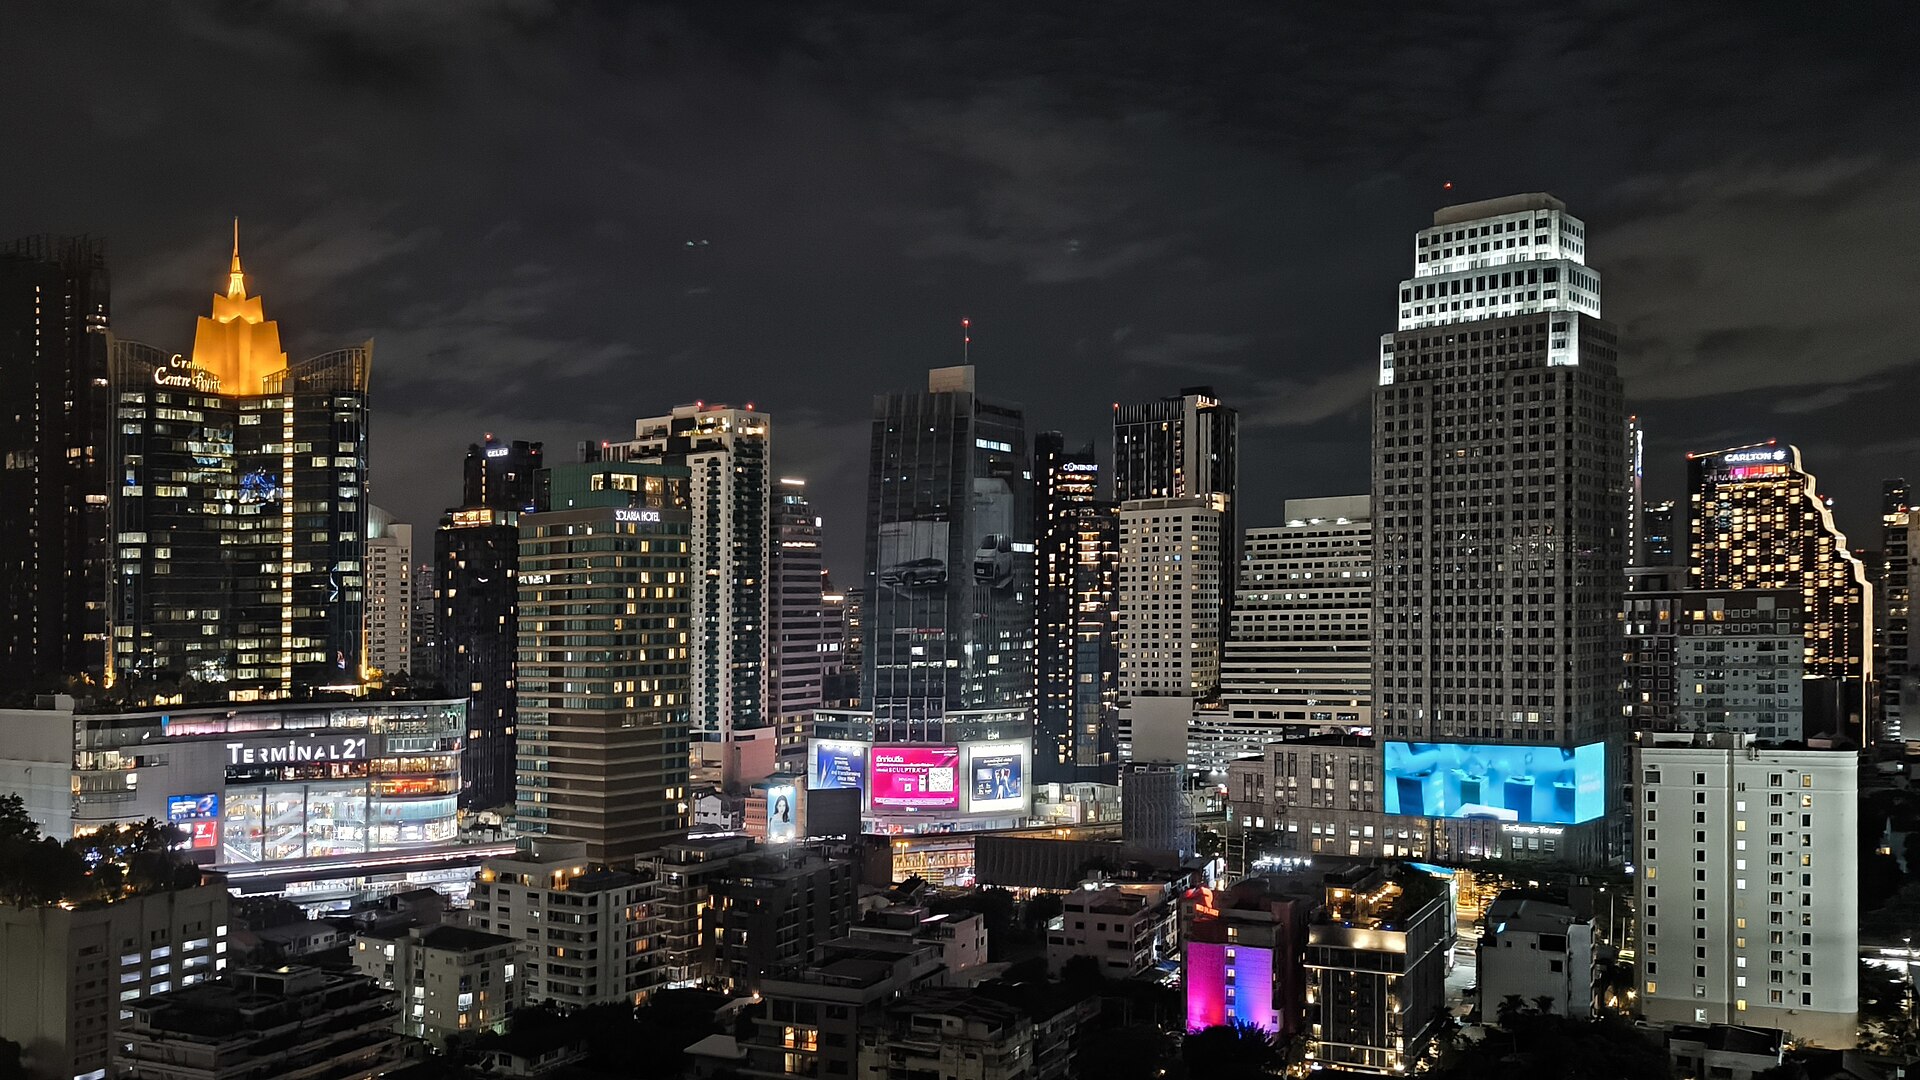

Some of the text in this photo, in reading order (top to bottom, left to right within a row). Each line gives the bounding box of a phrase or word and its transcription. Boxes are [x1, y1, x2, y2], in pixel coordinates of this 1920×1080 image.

[154, 366, 222, 389] Centre Point
[1724, 452, 1772, 462] CARLTON
[1063, 462, 1098, 471] CONTINENT
[615, 510, 660, 522] SOLARIA HOTEL
[226, 738, 366, 764] TERMINAL 21
[1502, 823, 1564, 835] Exchange Tower
